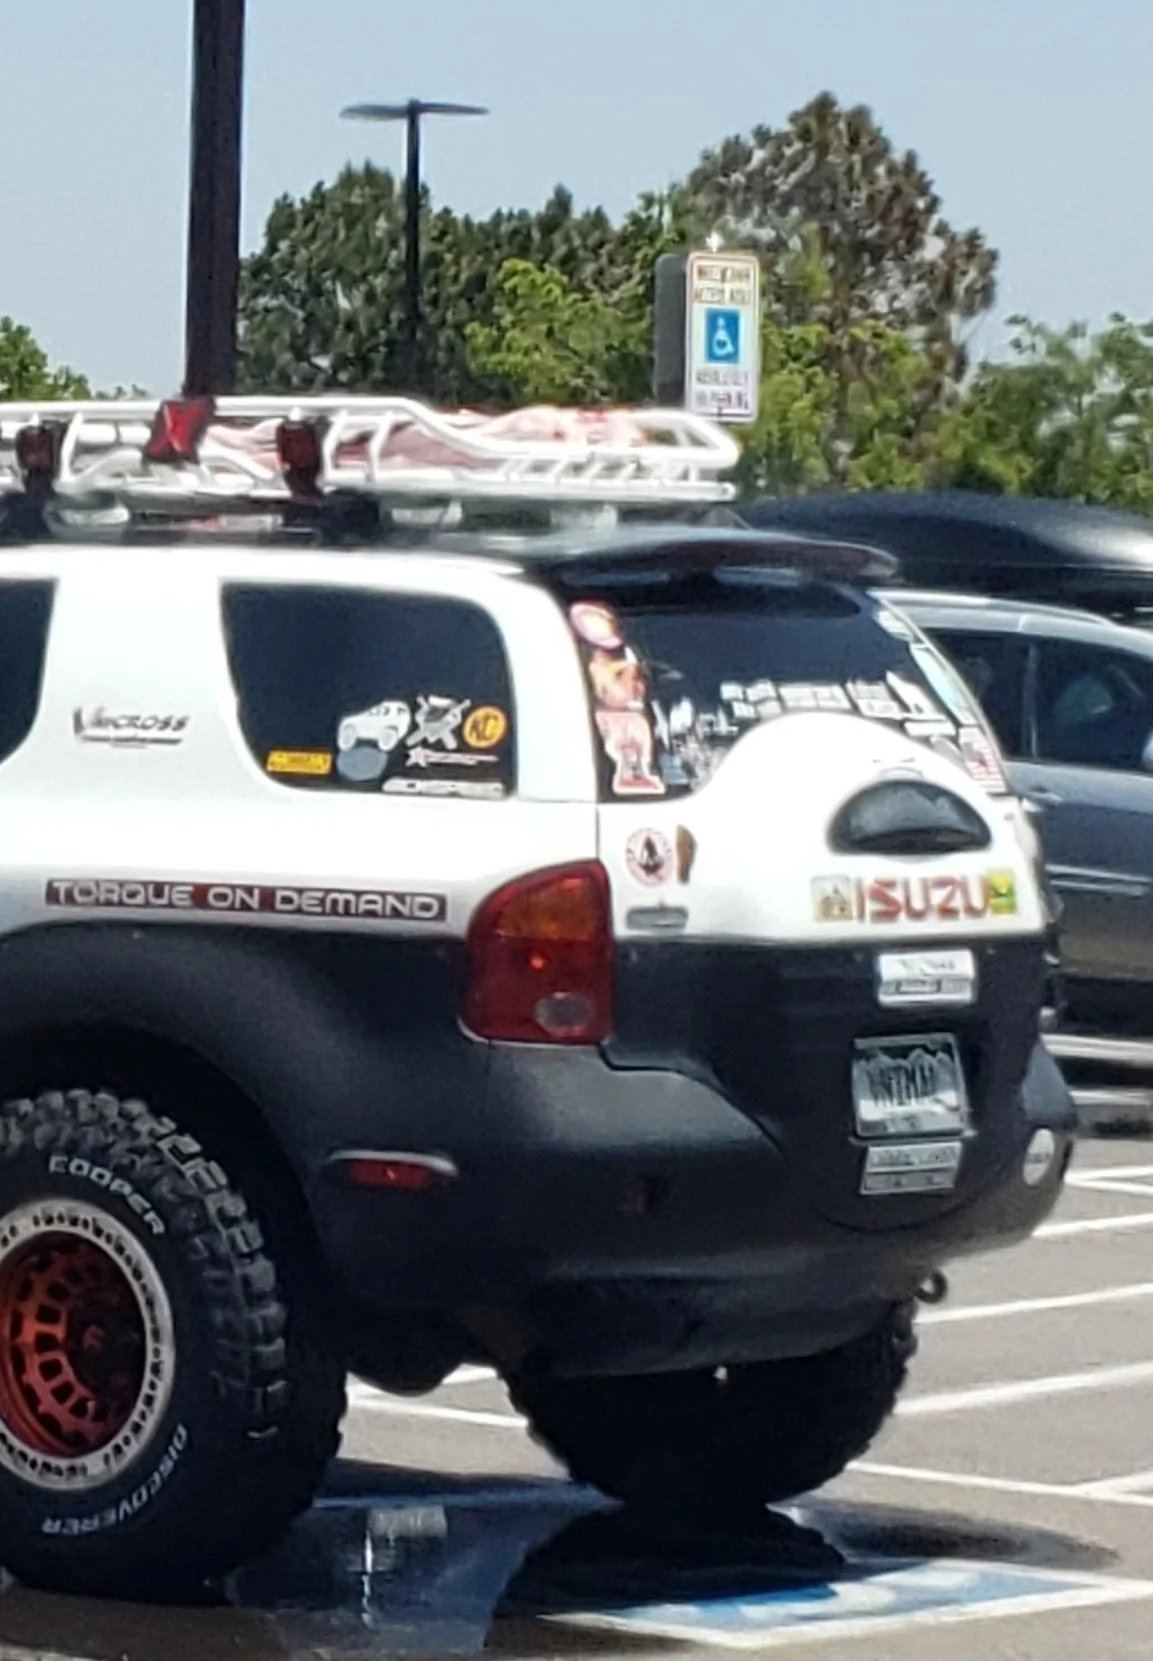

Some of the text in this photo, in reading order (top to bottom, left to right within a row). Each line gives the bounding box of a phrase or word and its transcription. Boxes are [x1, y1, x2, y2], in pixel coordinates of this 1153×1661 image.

[51, 880, 440, 919] TORQUE ON DEMAND
[854, 876, 990, 924] ISUZU
[49, 1155, 165, 1236] COOPER
[41, 1422, 188, 1535] DISCOVERER
